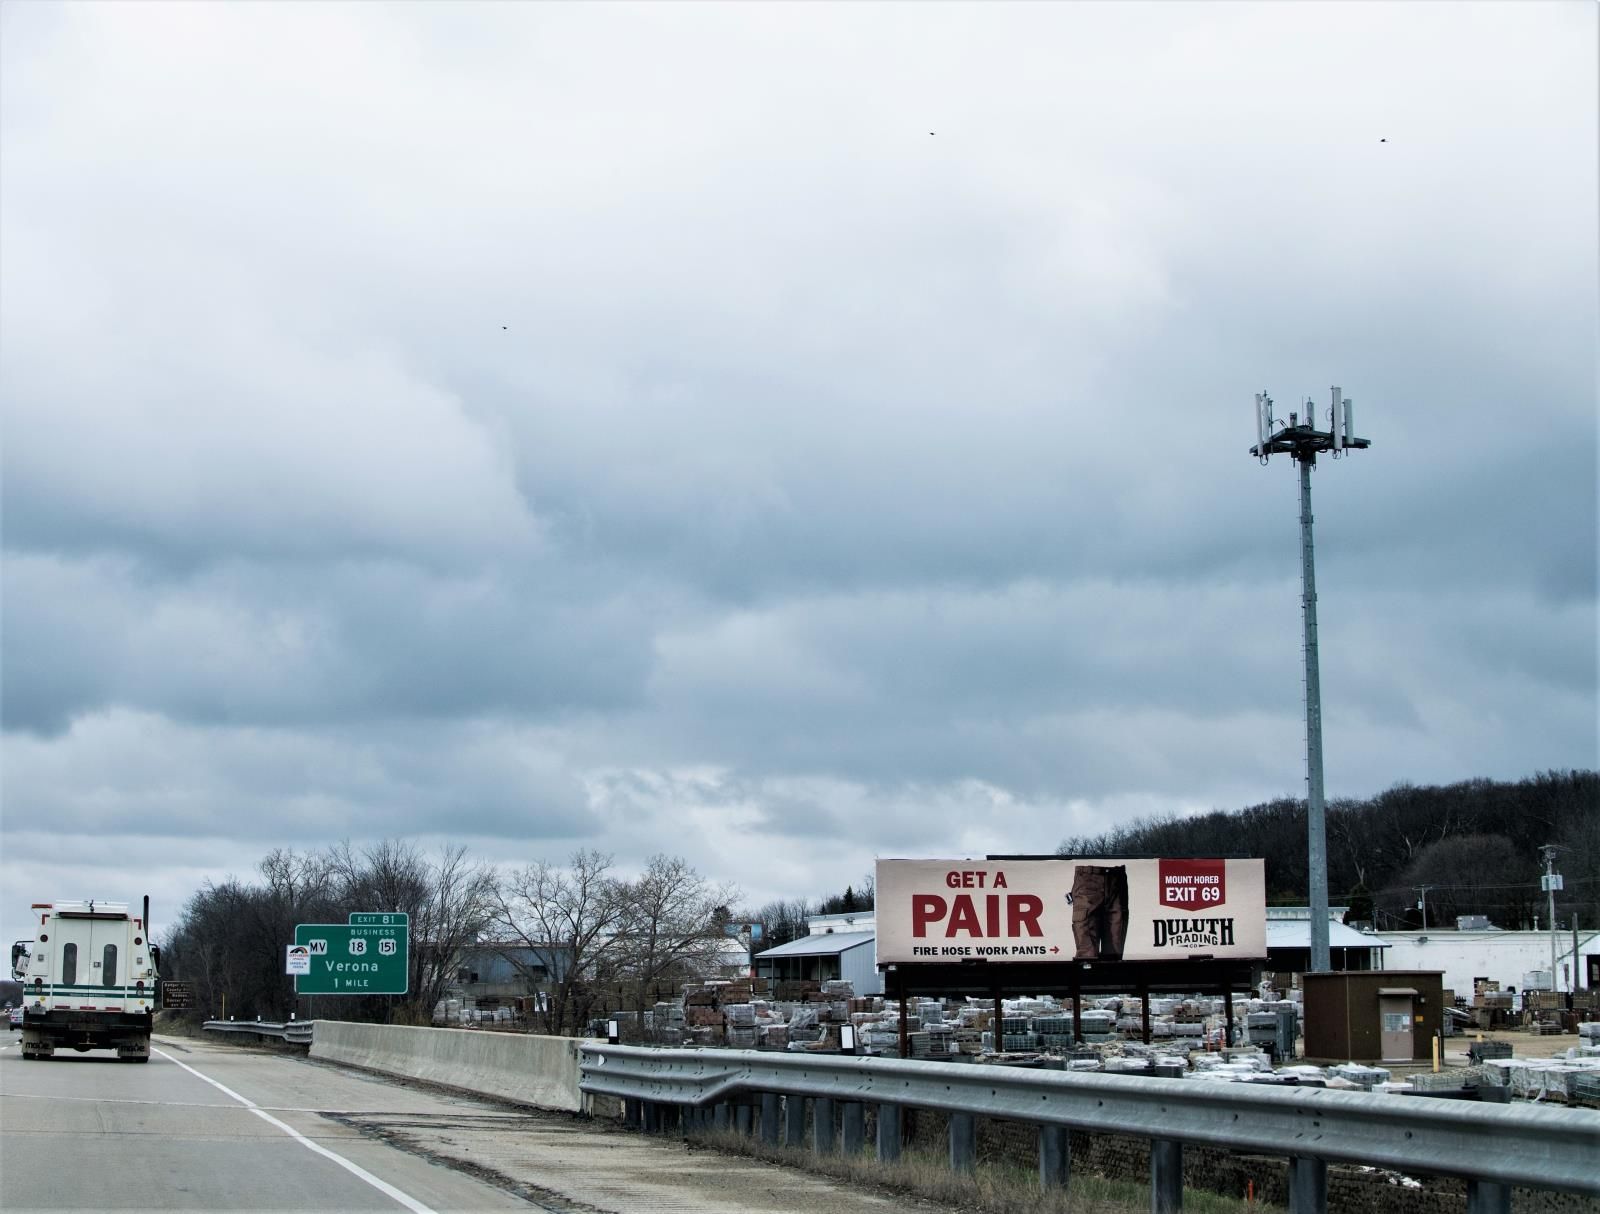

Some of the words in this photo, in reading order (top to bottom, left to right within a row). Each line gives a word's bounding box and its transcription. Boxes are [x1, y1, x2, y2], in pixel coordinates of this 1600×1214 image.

[946, 871, 987, 889] GET
[993, 871, 1008, 889] A
[1165, 875, 1193, 884] MOUNT
[1194, 875, 1219, 884] HOREB
[1166, 887, 1197, 902] EXIT
[1202, 887, 1220, 901] 69
[382, 915, 395, 924] 81
[912, 894, 1044, 938] PAIR
[1152, 918, 1235, 948] DULUTH
[1168, 933, 1218, 947] TRADING
[310, 942, 326, 952] MV
[351, 941, 364, 952] 18
[380, 942, 396, 952] 151
[913, 946, 938, 956] FIRE
[941, 946, 971, 956] HOSE
[975, 946, 1009, 955] WORK
[1012, 945, 1047, 955] PANTS
[325, 960, 379, 972] Verona
[334, 978, 339, 988] 1
[345, 979, 369, 987] MILE
